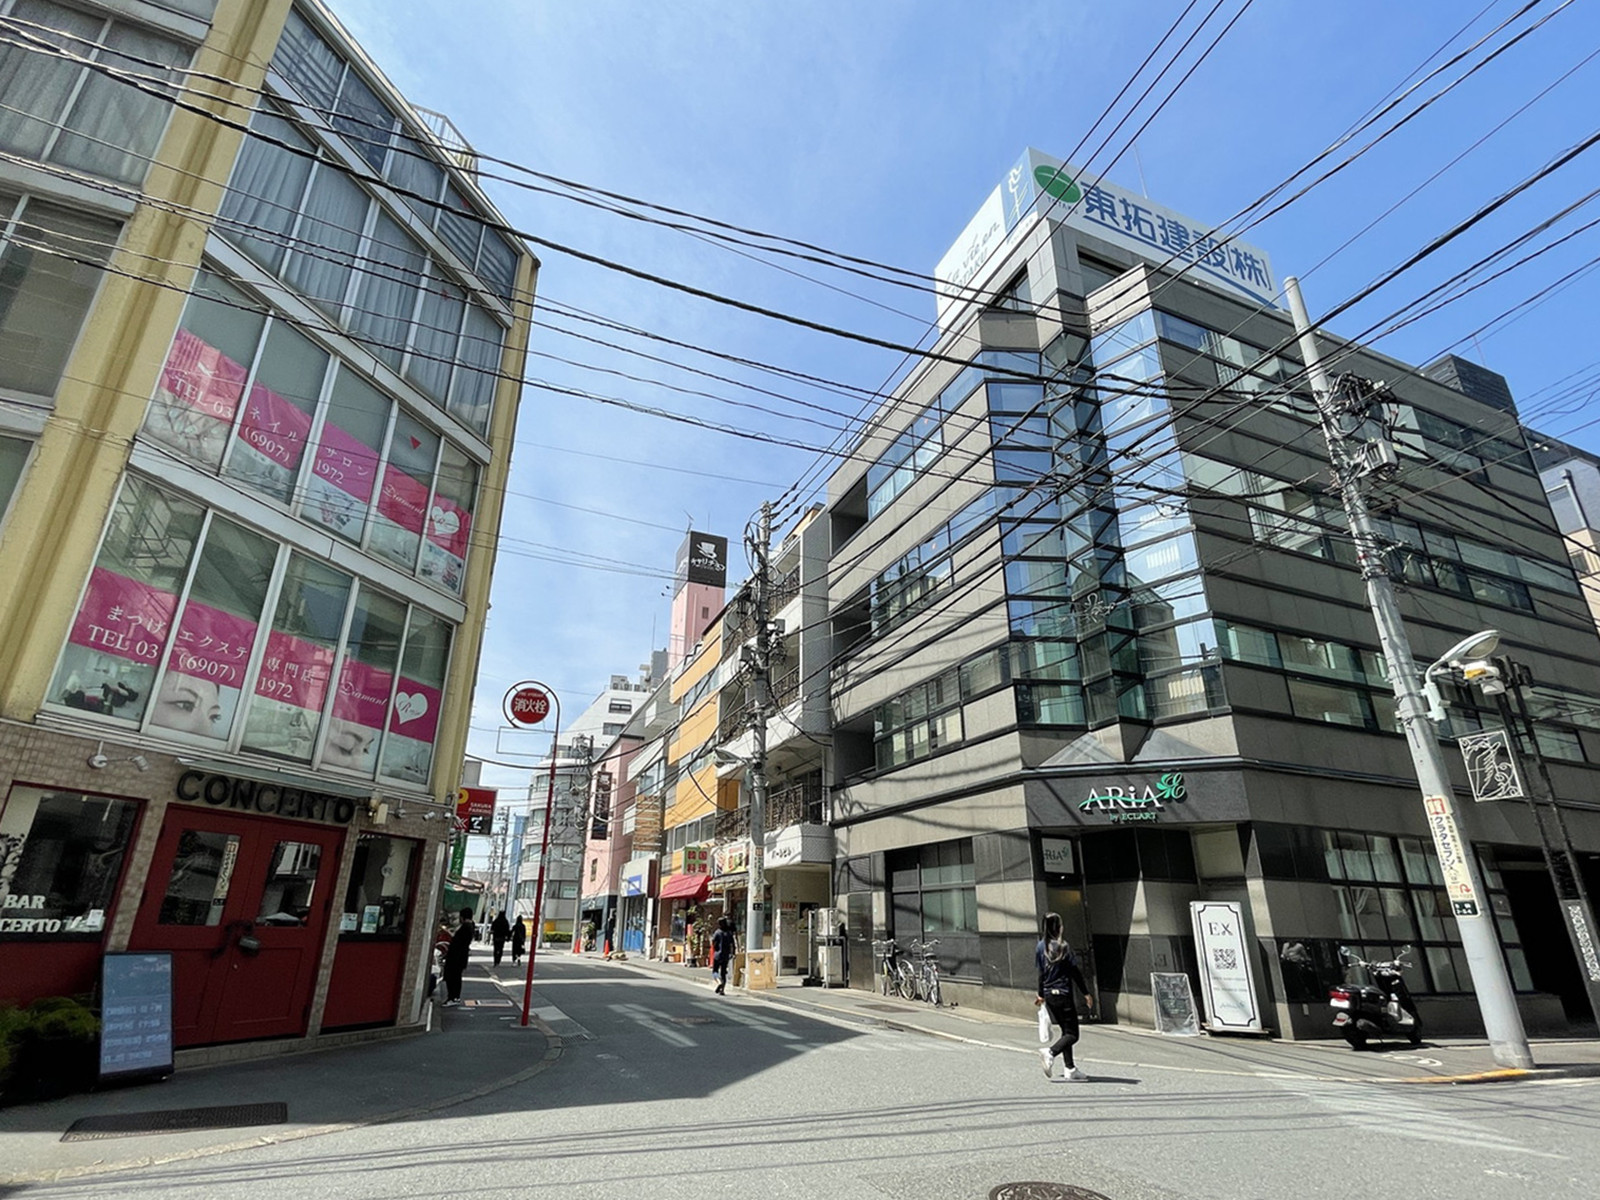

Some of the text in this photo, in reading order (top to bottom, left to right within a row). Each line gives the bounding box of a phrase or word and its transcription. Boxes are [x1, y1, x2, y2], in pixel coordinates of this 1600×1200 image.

[174, 374, 233, 418] TEL 03
[250, 406, 299, 442] ネイル
[316, 459, 345, 485] 1972
[325, 446, 369, 476] サロン
[107, 605, 167, 634] まつげ
[88, 624, 159, 659] TEL 03
[178, 629, 248, 660] エクステ
[178, 651, 236, 682] (6907)
[259, 677, 294, 699] 1972
[514, 697, 547, 714] 消火栓
[176, 770, 355, 824] CONCERTO
[1121, 812, 1157, 820] ECLART
[2, 894, 46, 909] BAR
[1208, 922, 1233, 936] EX
